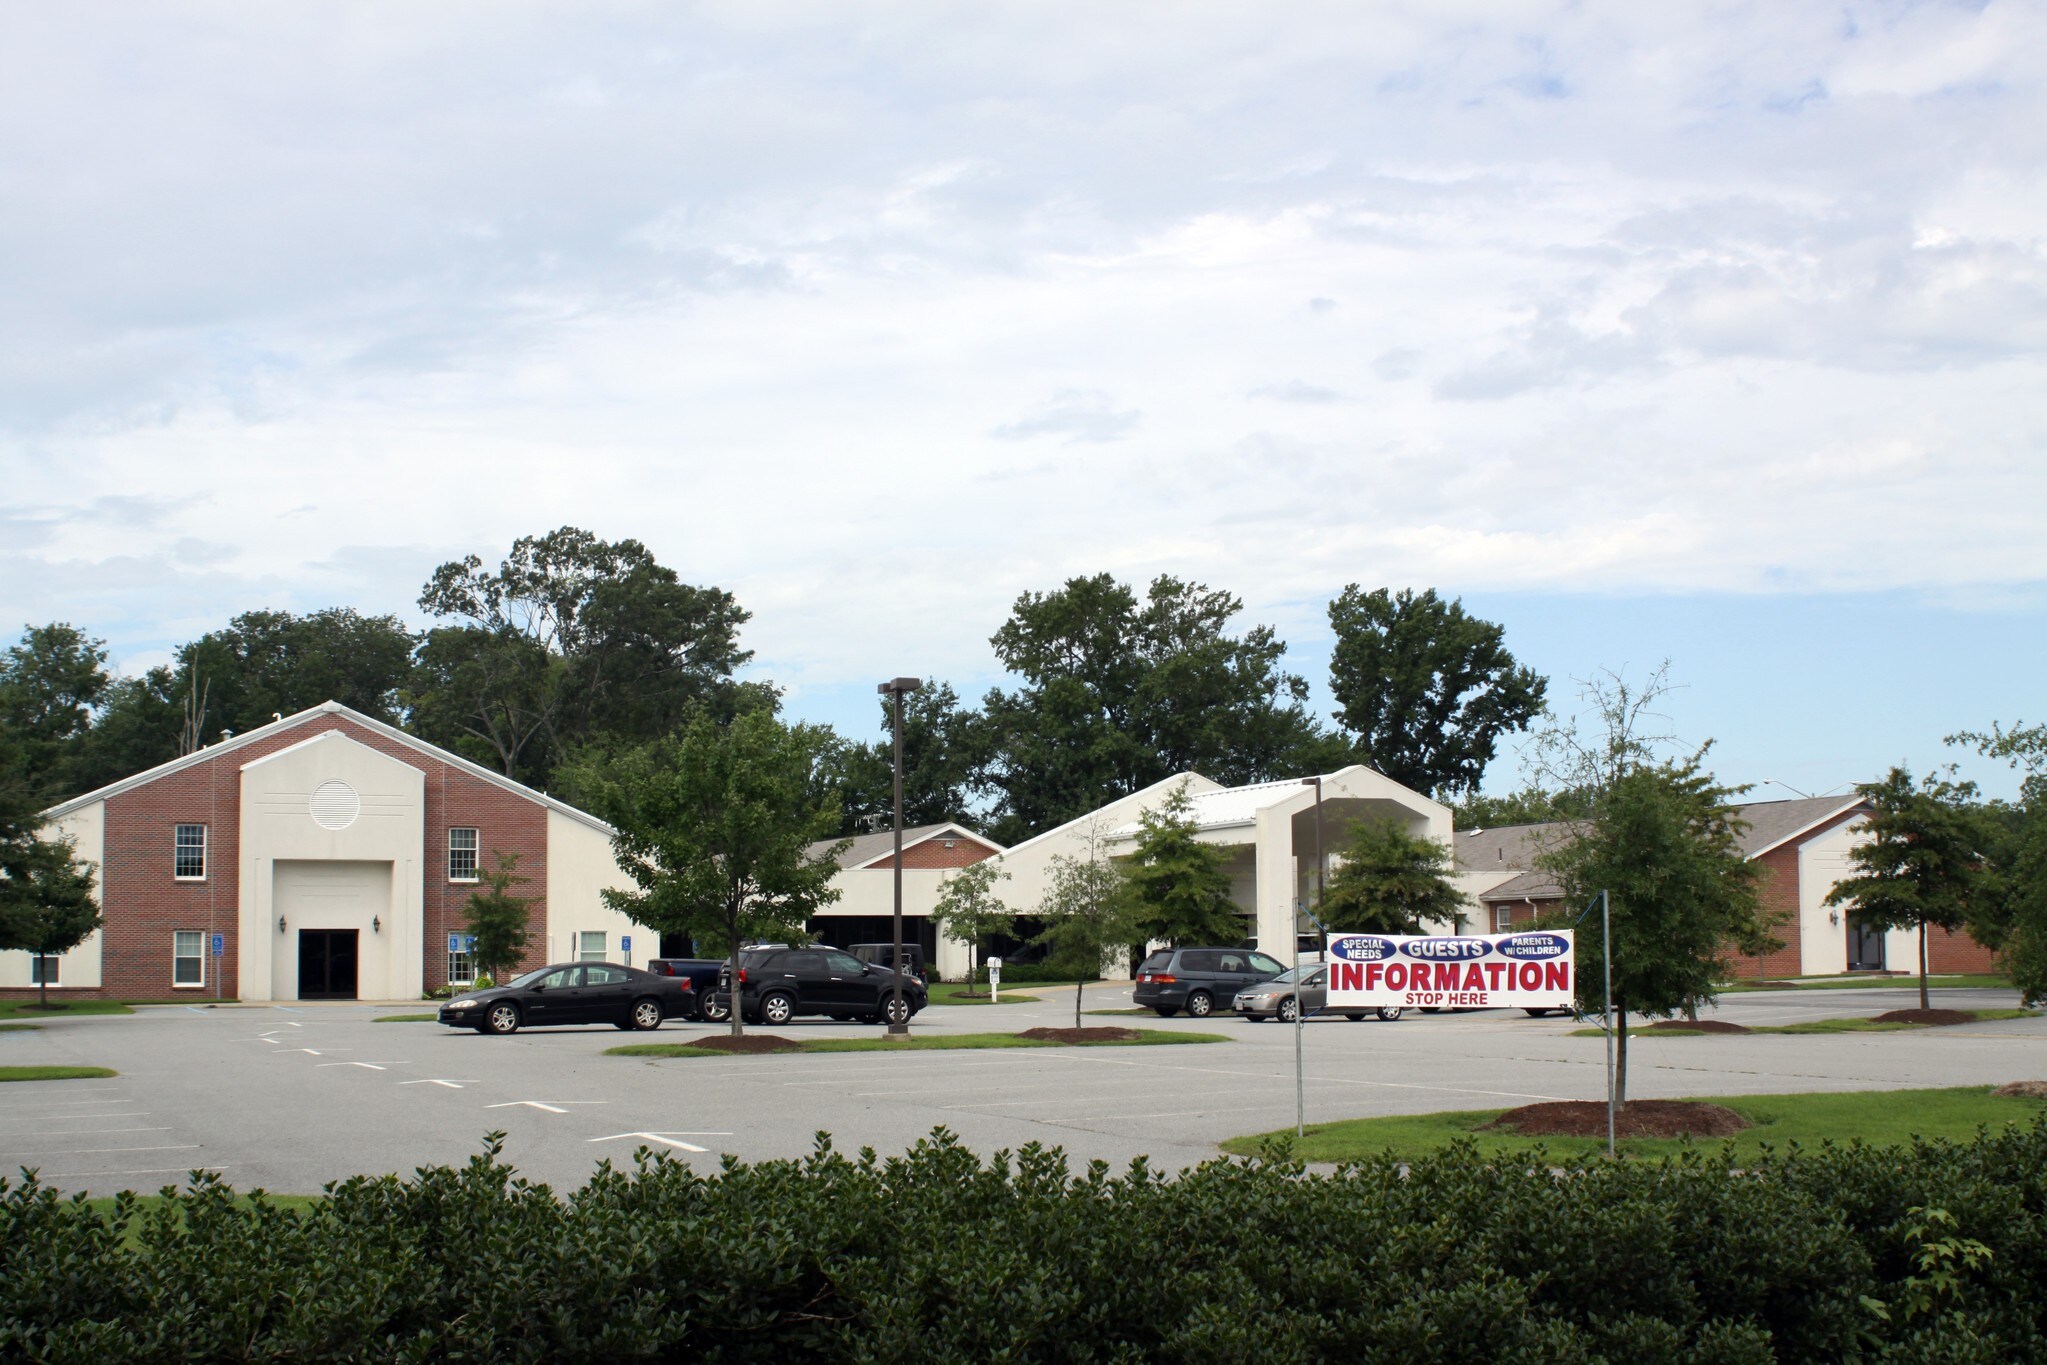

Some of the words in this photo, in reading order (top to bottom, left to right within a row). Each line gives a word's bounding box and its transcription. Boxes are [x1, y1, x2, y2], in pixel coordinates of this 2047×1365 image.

[1342, 939, 1385, 949] SPECIAL
[1511, 937, 1554, 946] PARENTS
[1346, 949, 1382, 959] NEEDS
[1408, 940, 1484, 957] GUESTS
[1330, 961, 1569, 991] INFORMATION
[1405, 992, 1443, 1005] STOP
[1448, 993, 1488, 1005] HERE
